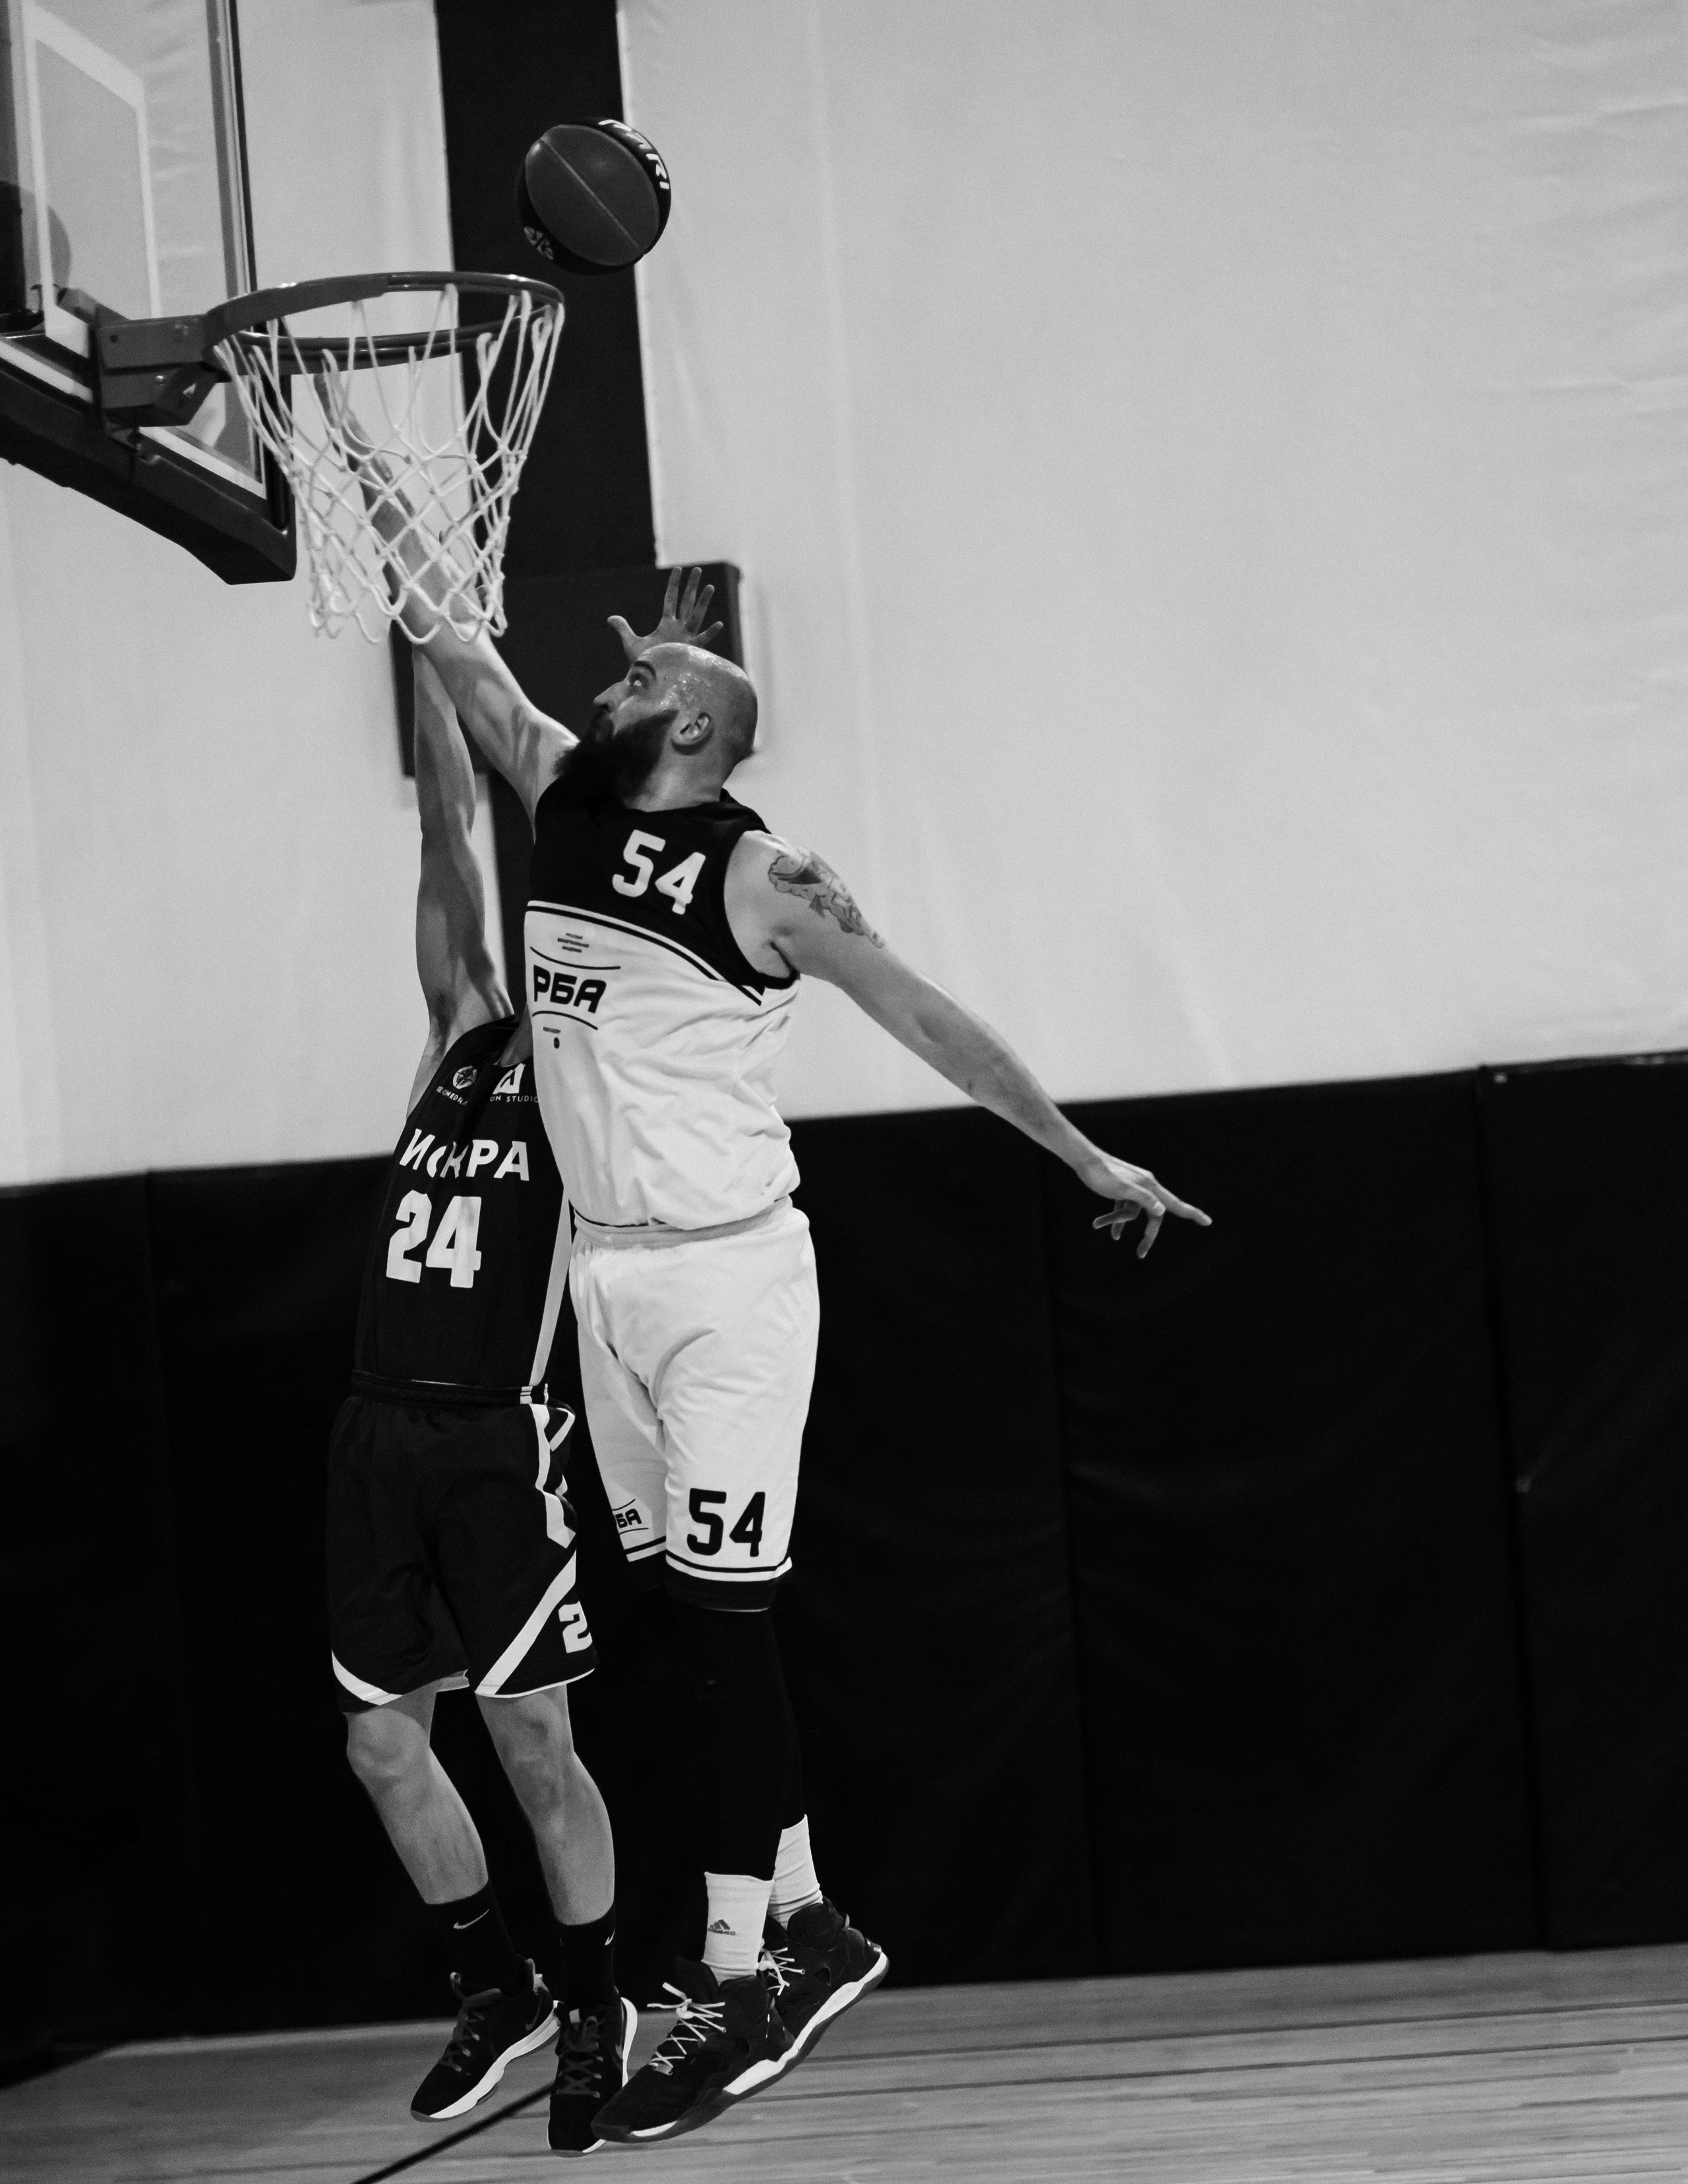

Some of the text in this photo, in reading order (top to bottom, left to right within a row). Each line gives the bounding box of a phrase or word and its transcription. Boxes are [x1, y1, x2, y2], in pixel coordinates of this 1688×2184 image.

[612, 829, 706, 915] 54
[533, 964, 607, 1014] РБА
[386, 1189, 482, 1289] 24
[615, 1508, 643, 1529] БА
[686, 1487, 766, 1558] 54
[558, 1600, 593, 1654] 2
